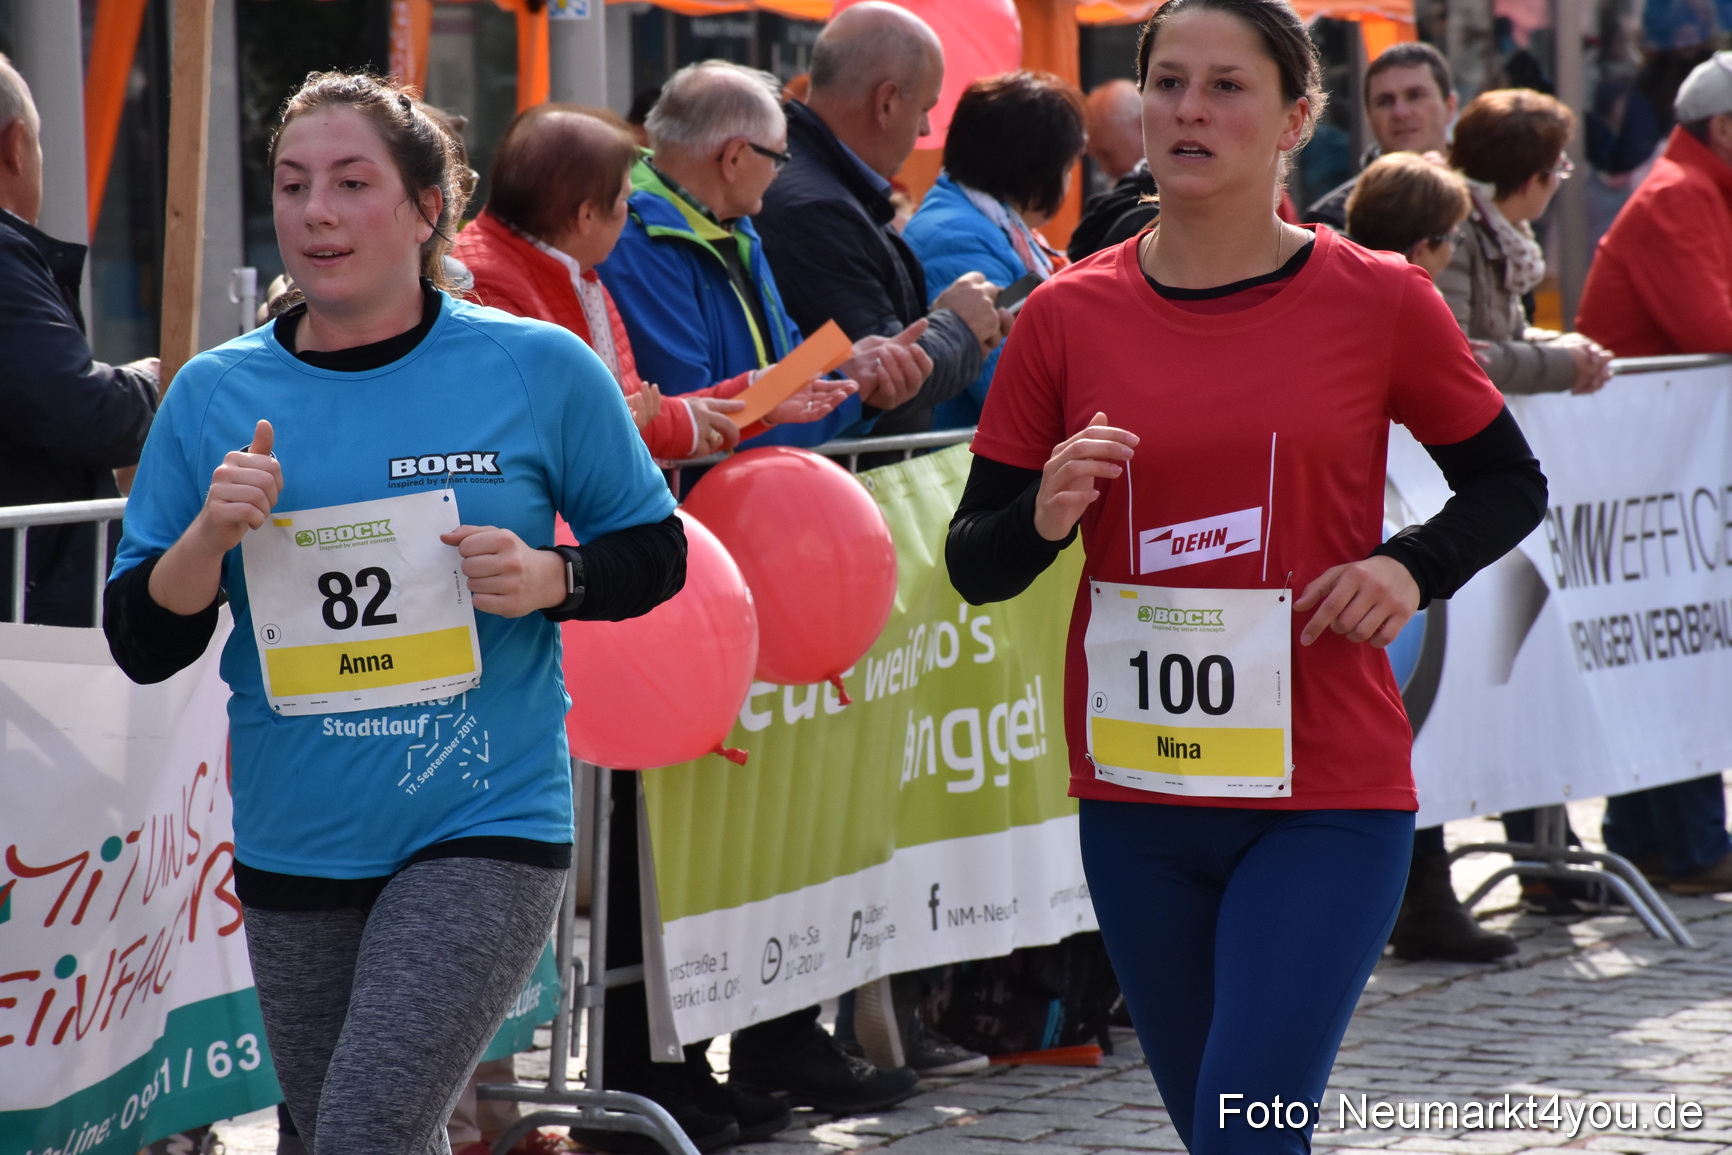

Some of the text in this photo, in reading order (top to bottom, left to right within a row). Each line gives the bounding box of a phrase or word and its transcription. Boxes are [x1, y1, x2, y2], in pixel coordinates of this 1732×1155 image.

[390, 452, 501, 479] BOCK
[388, 476, 506, 489] inspired by smart concepts
[317, 518, 395, 544] BOCK
[1171, 527, 1228, 555] DEHN
[319, 543, 343, 551] inspired
[343, 541, 351, 549] by
[369, 536, 396, 544] concepts
[1546, 501, 1619, 589] BMW
[317, 566, 398, 630] 82
[1152, 624, 1172, 632] inspired
[1172, 625, 1180, 633] by
[1153, 607, 1225, 626] BOCK
[267, 629, 275, 640] D
[339, 652, 395, 676] Anna
[1129, 650, 1235, 716] 100
[1096, 697, 1103, 708] D
[322, 714, 431, 738] Stadtlauf
[405, 715, 478, 796] 17. September 2017
[1157, 735, 1202, 760] Nina
[720, 951, 729, 971] 1
[182, 1047, 193, 1088] /
[206, 1033, 262, 1078] 63
